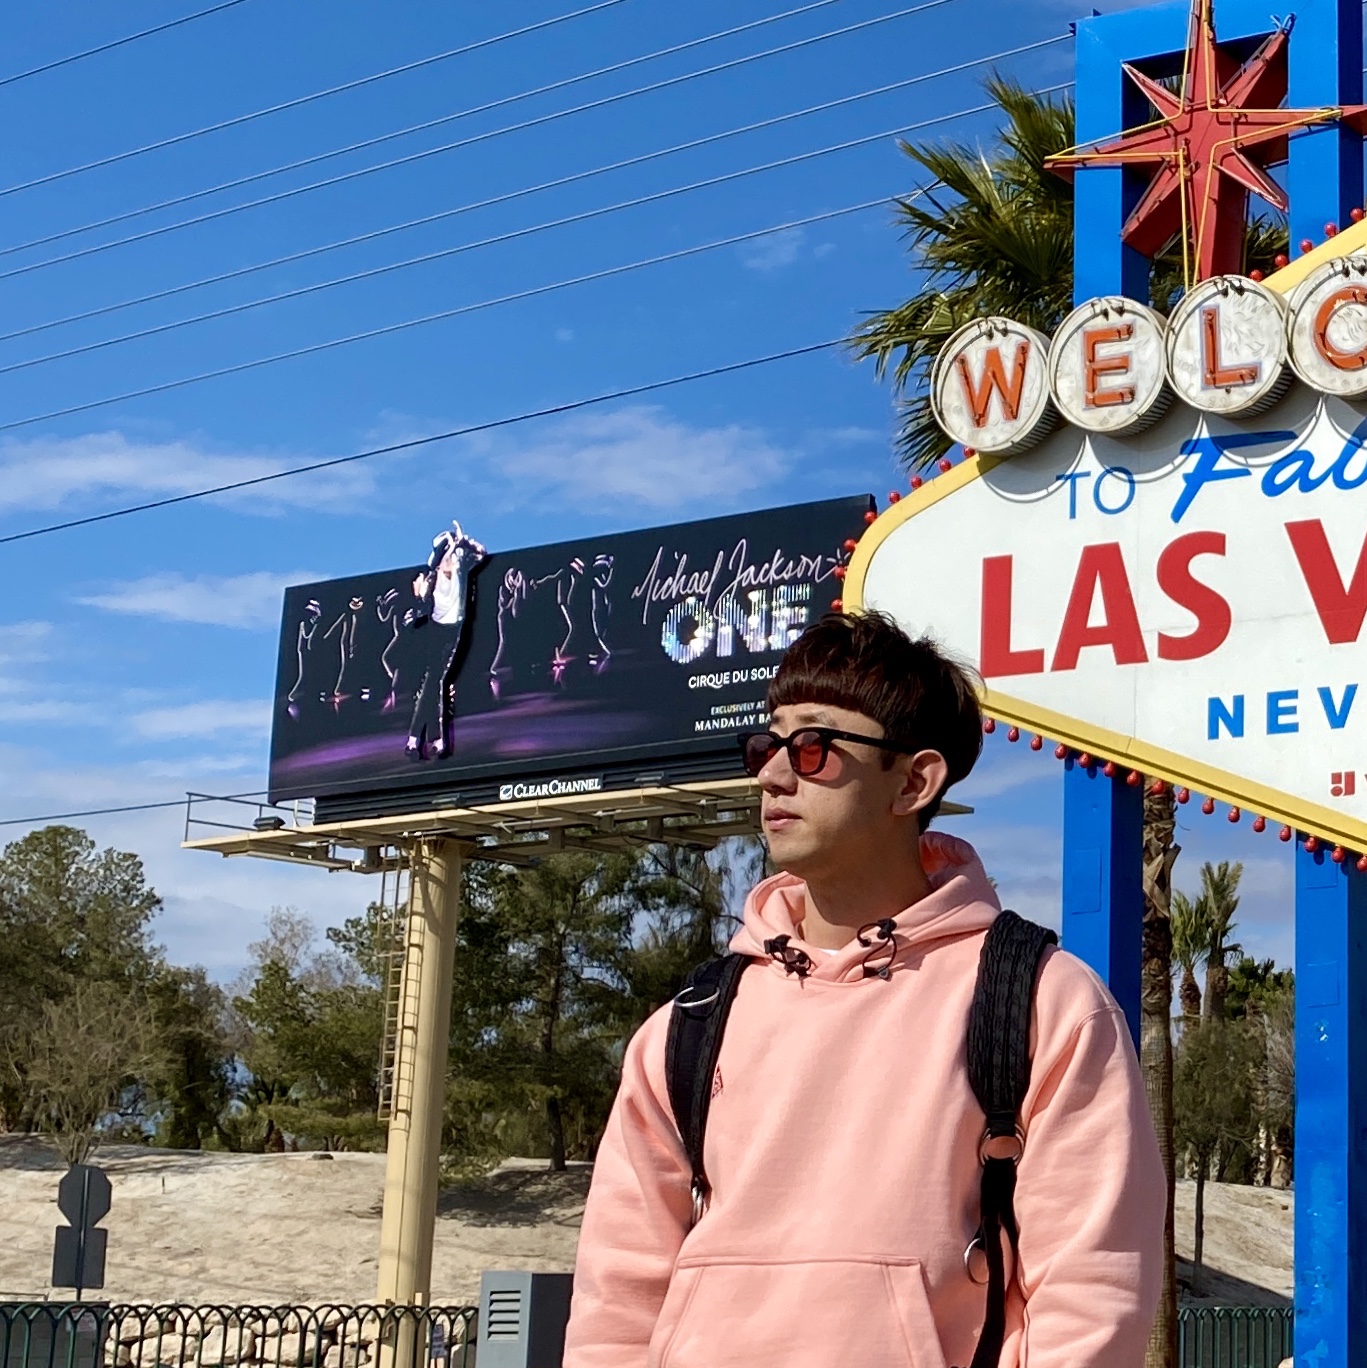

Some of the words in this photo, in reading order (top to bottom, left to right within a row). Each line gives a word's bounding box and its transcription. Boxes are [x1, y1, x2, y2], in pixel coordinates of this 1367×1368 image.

[1055, 466, 1136, 520] TO
[631, 546, 725, 626] Michael
[713, 538, 838, 622] Jackson
[980, 530, 1233, 679] LAS
[661, 583, 811, 664] ONE
[688, 671, 730, 689] CIRQUE
[732, 669, 749, 683] DU
[750, 665, 780, 681] SOLE
[694, 714, 756, 732] MANDALAY
[758, 712, 772, 724] BA
[710, 702, 755, 716] EXCLUSIVELY
[756, 700, 766, 710] AT
